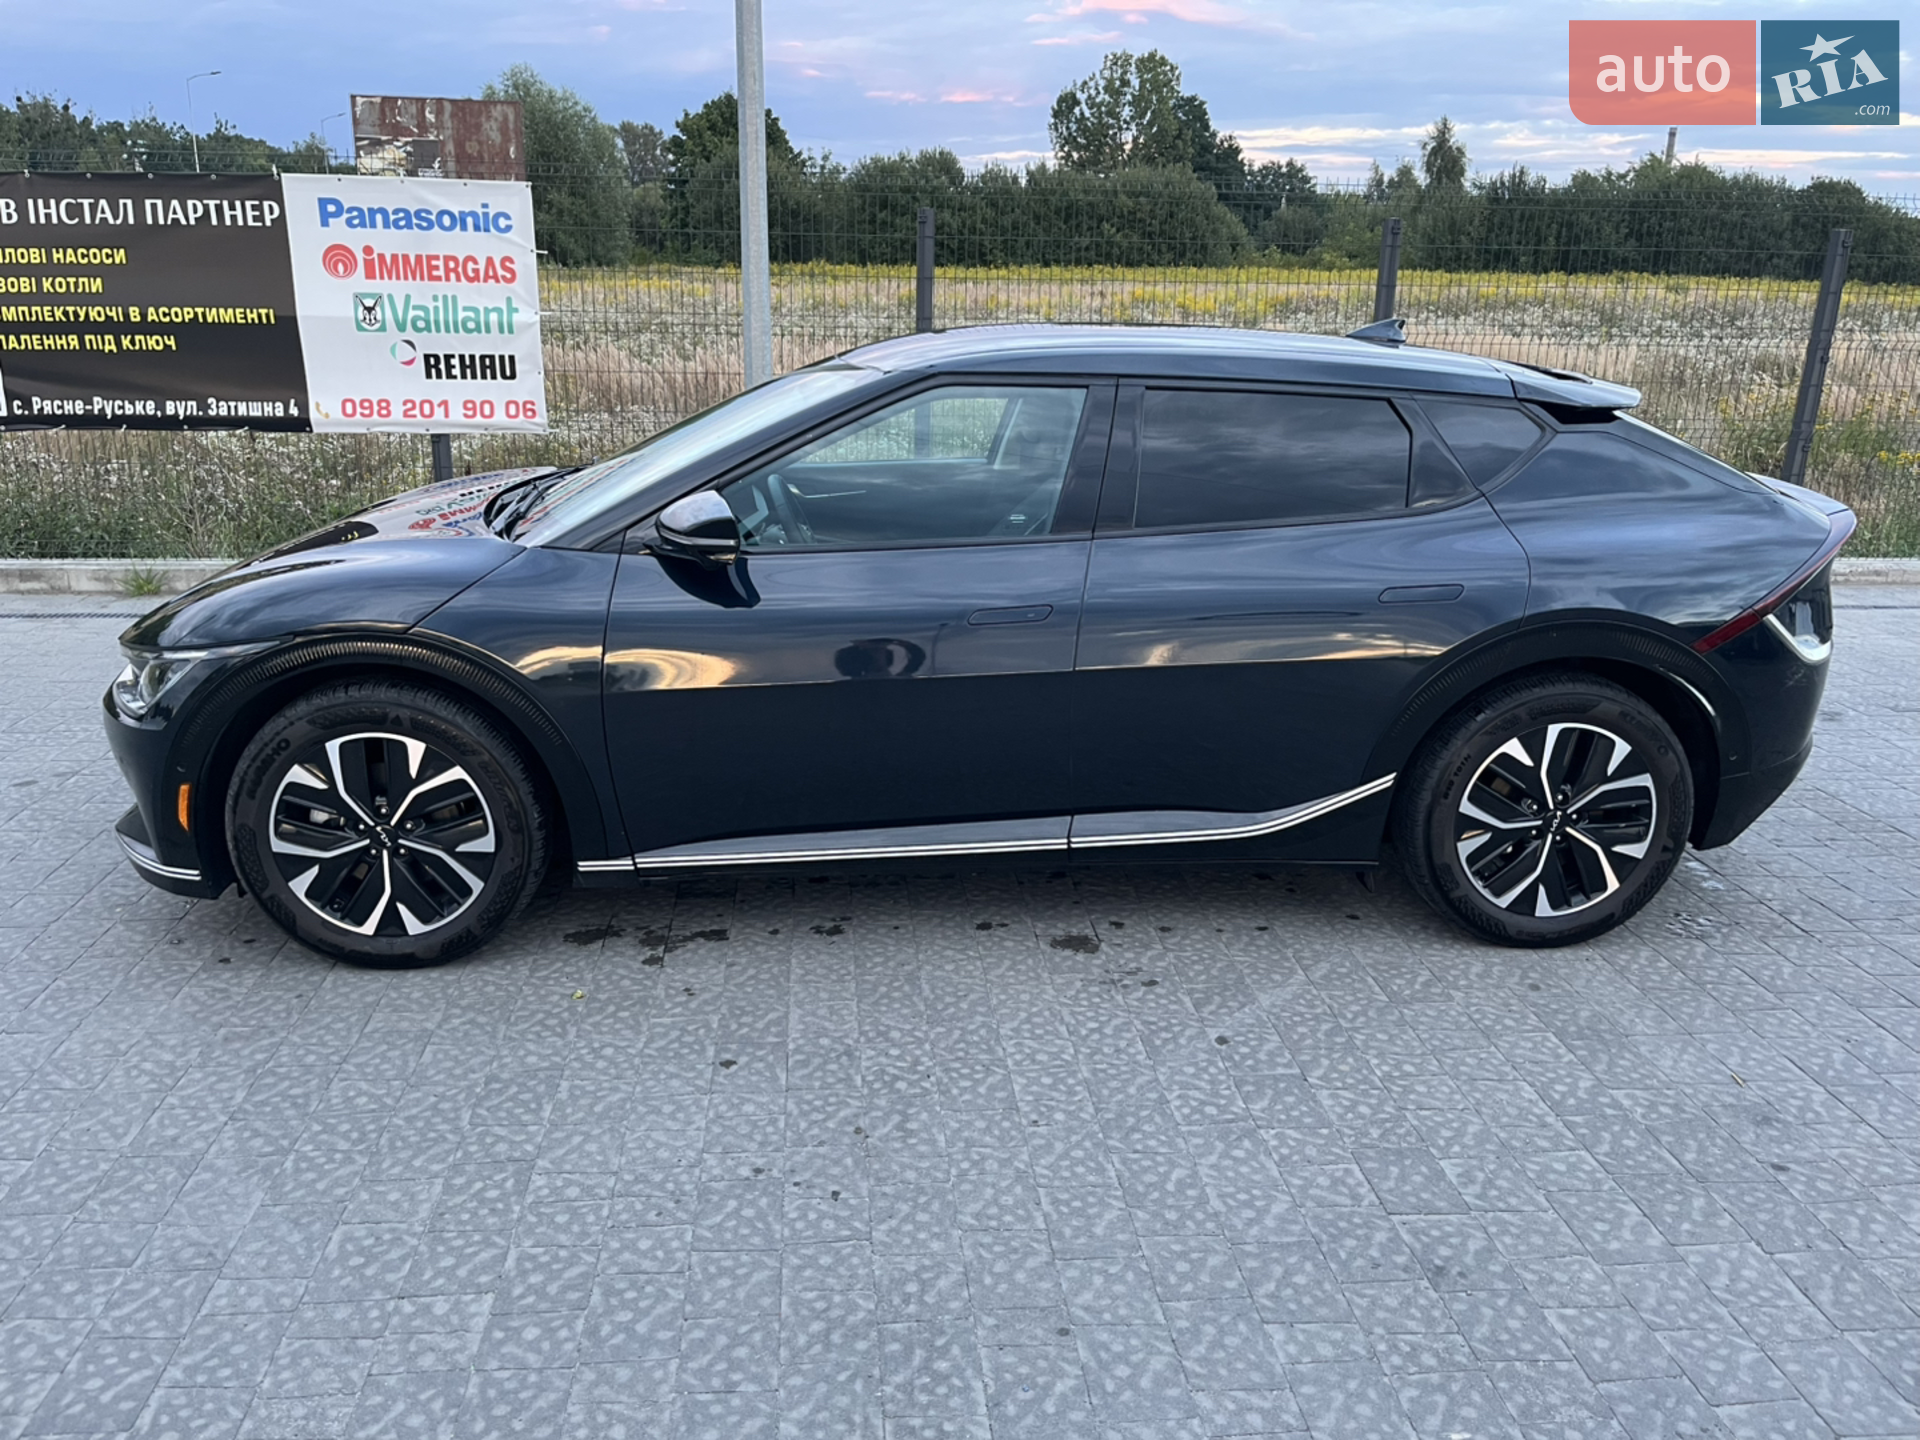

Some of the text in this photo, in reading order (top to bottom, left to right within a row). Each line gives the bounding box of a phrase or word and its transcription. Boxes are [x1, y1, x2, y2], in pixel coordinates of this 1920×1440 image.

[28, 199, 134, 224] ІНСТАЛ
[145, 199, 279, 226] ПАРТНЕР
[317, 197, 512, 234] Panasonic
[52, 248, 126, 264] НАСОСИ
[42, 277, 102, 293] КОТЛИ
[0, 306, 274, 324] МПЛЕКТУЮЧІ В АСОРТИМЕНТІ
[387, 293, 519, 335] Vaillant
[85, 335, 117, 353] ПІД
[121, 335, 176, 350] КЛЮЧ
[424, 354, 516, 380] REHAU
[13, 397, 299, 419] с. Рясне-Руське, вул. Затишна 4
[340, 397, 538, 419] 098 201 90 06
